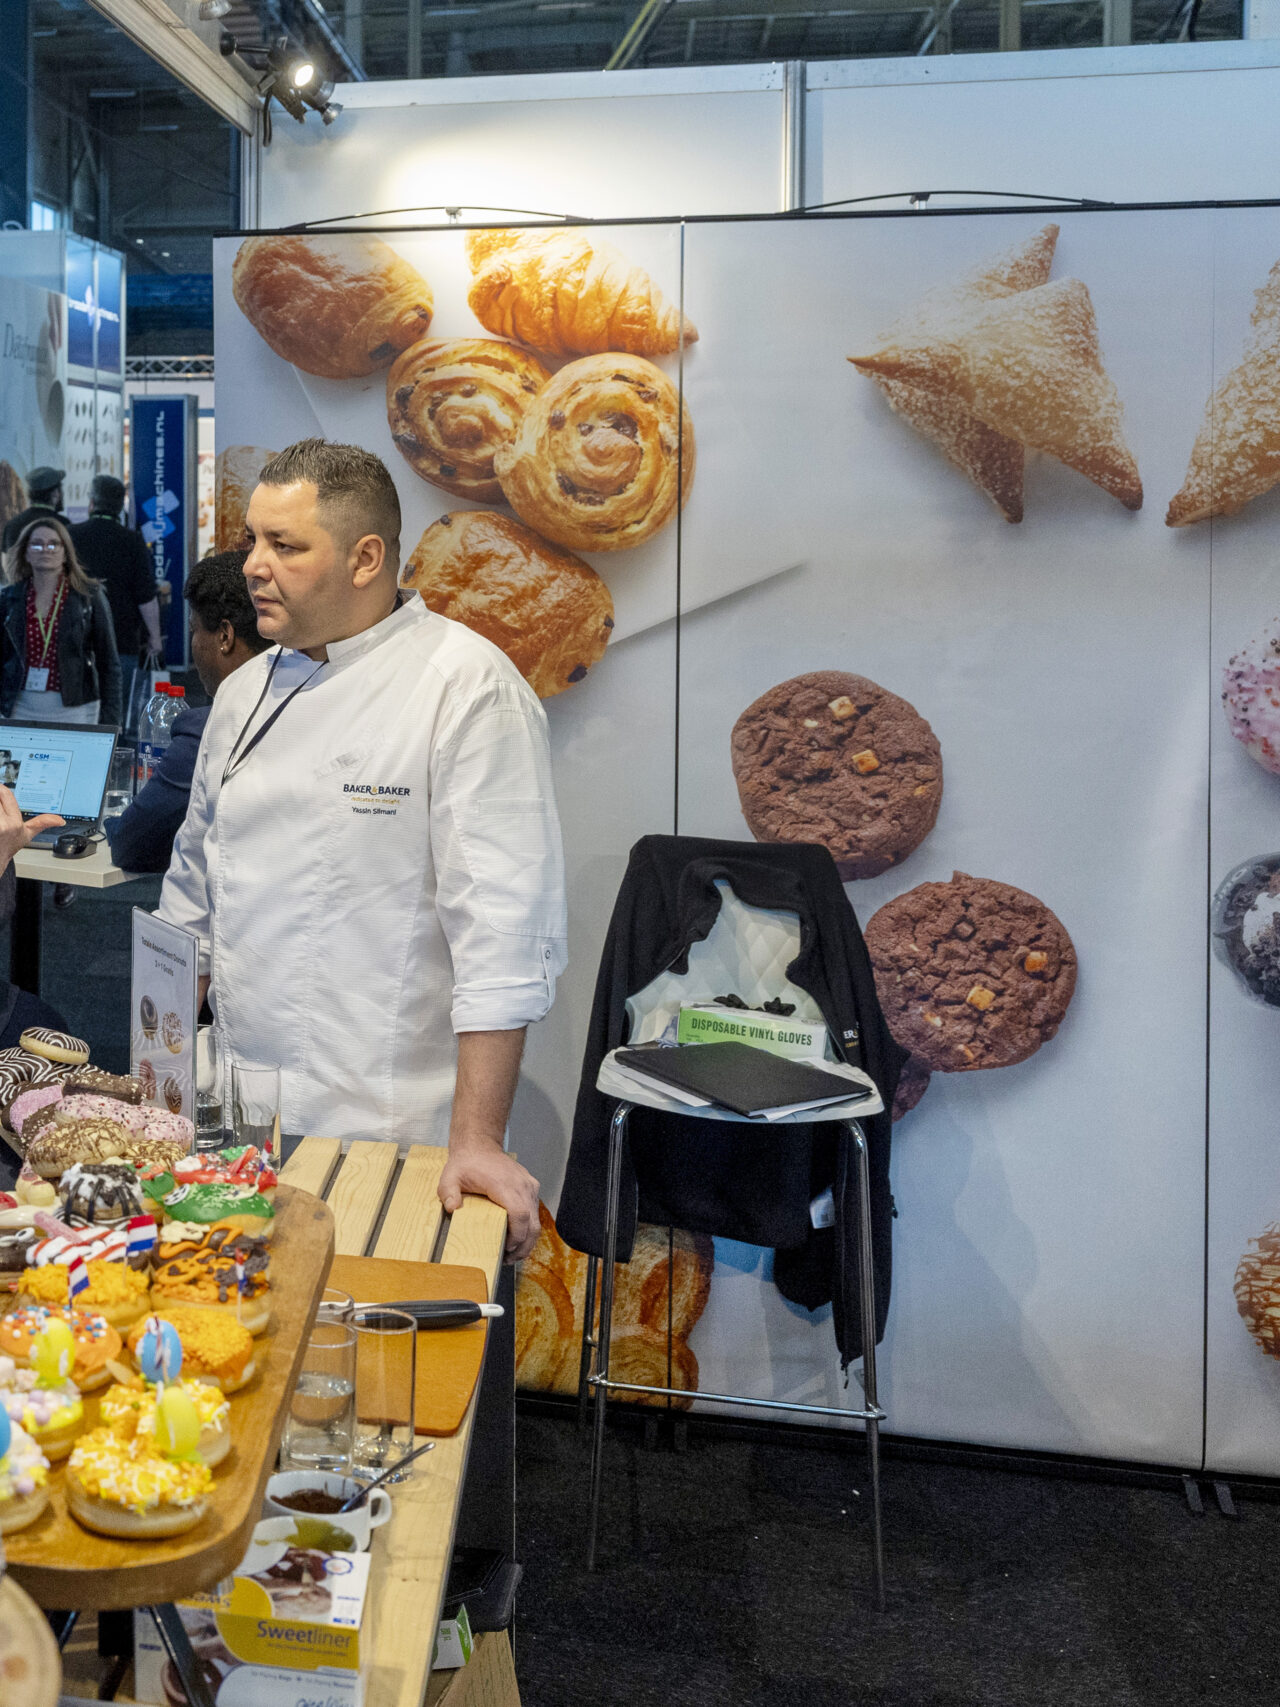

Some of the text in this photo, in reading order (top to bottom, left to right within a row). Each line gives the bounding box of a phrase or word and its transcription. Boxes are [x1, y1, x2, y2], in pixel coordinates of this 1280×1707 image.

[691, 1018, 813, 1046] DISPOSABLE VINYL GLOVES
[257, 1619, 353, 1649] Sweetliner
